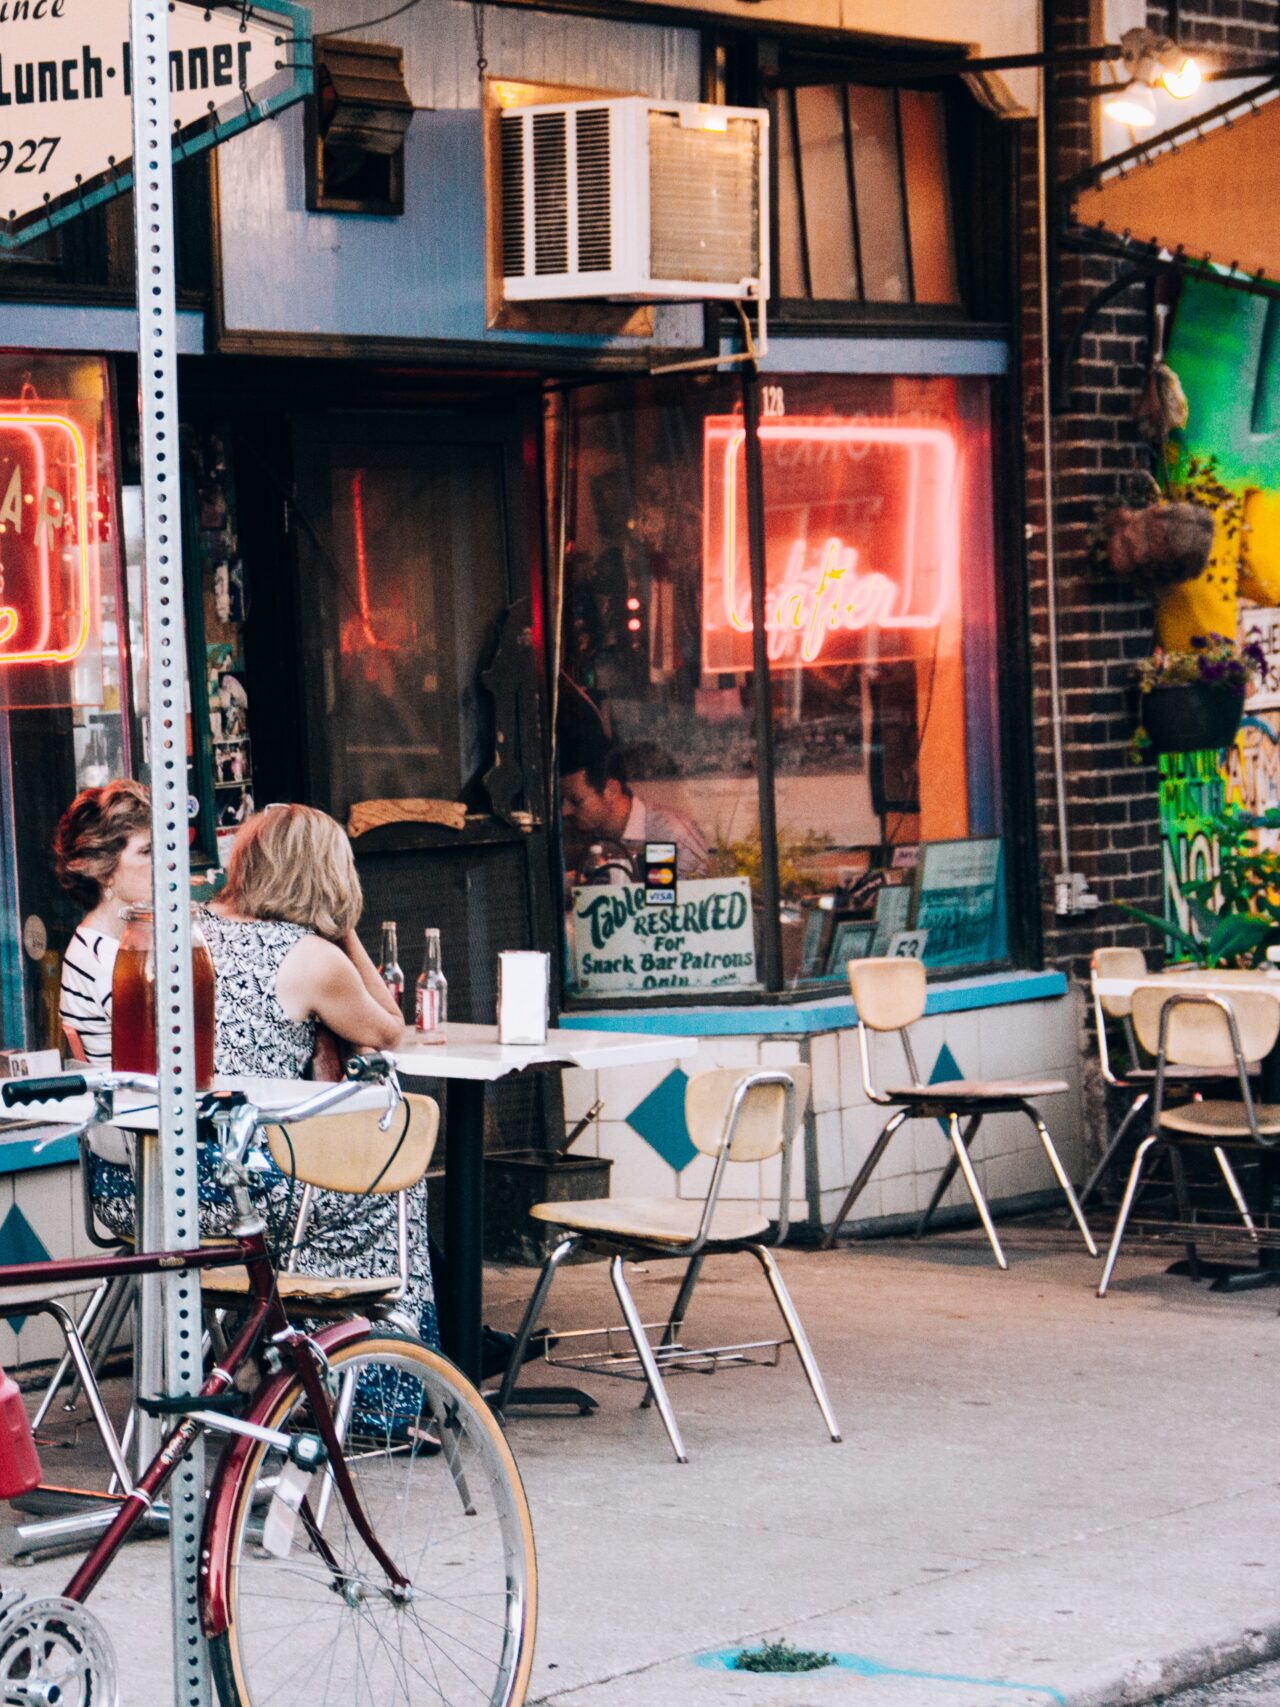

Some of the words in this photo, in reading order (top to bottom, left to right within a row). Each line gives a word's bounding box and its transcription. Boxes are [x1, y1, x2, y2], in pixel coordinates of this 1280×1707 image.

[122, 41, 252, 96] nner
[761, 386, 785, 417] 128
[649, 892, 674, 901] VISA
[577, 886, 646, 950] Table
[581, 953, 637, 975] Snack
[640, 953, 678, 972] Bar
[679, 951, 754, 971] Patrons
